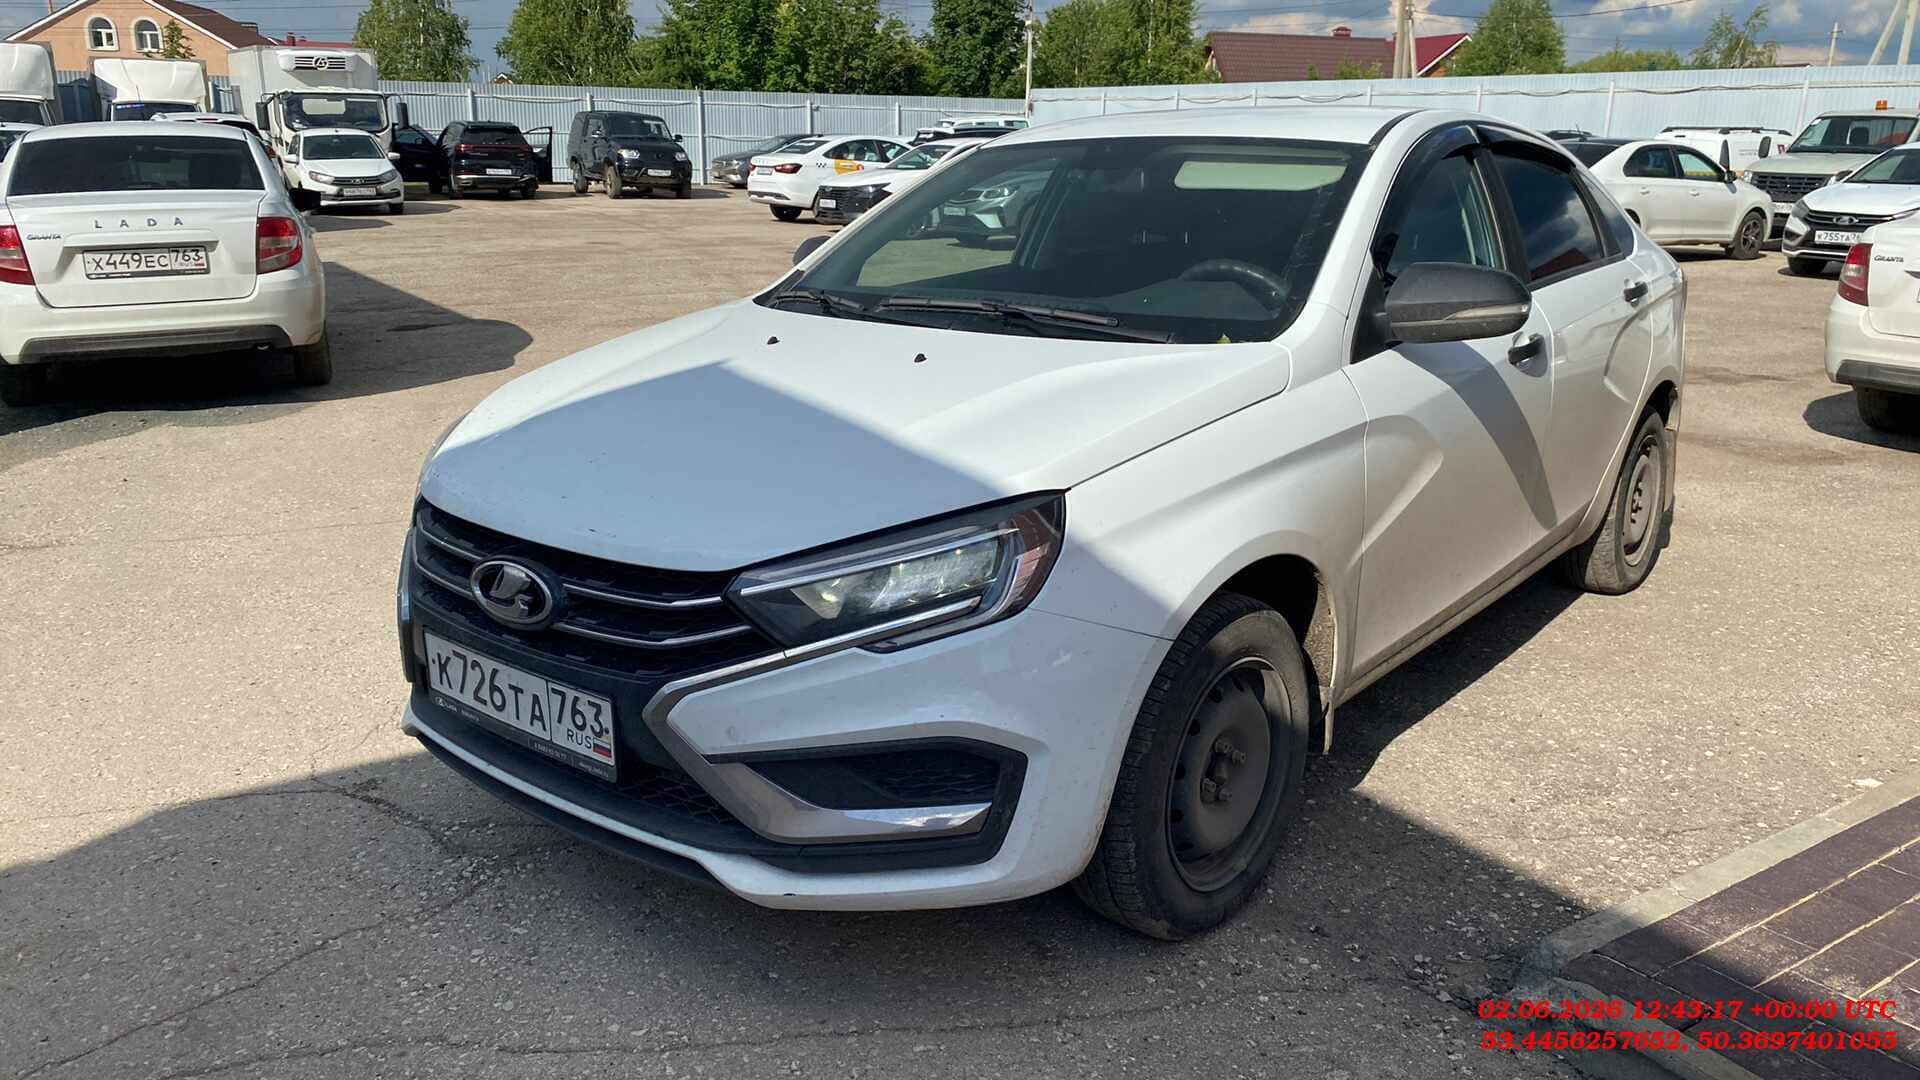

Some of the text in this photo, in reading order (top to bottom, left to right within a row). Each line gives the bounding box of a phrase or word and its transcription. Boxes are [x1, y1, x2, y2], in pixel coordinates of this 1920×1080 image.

[94, 217, 183, 229] LADA
[93, 249, 200, 271] Х449ЕС 763
[437, 650, 603, 738] К726ТА 763
[566, 728, 593, 749] RUS
